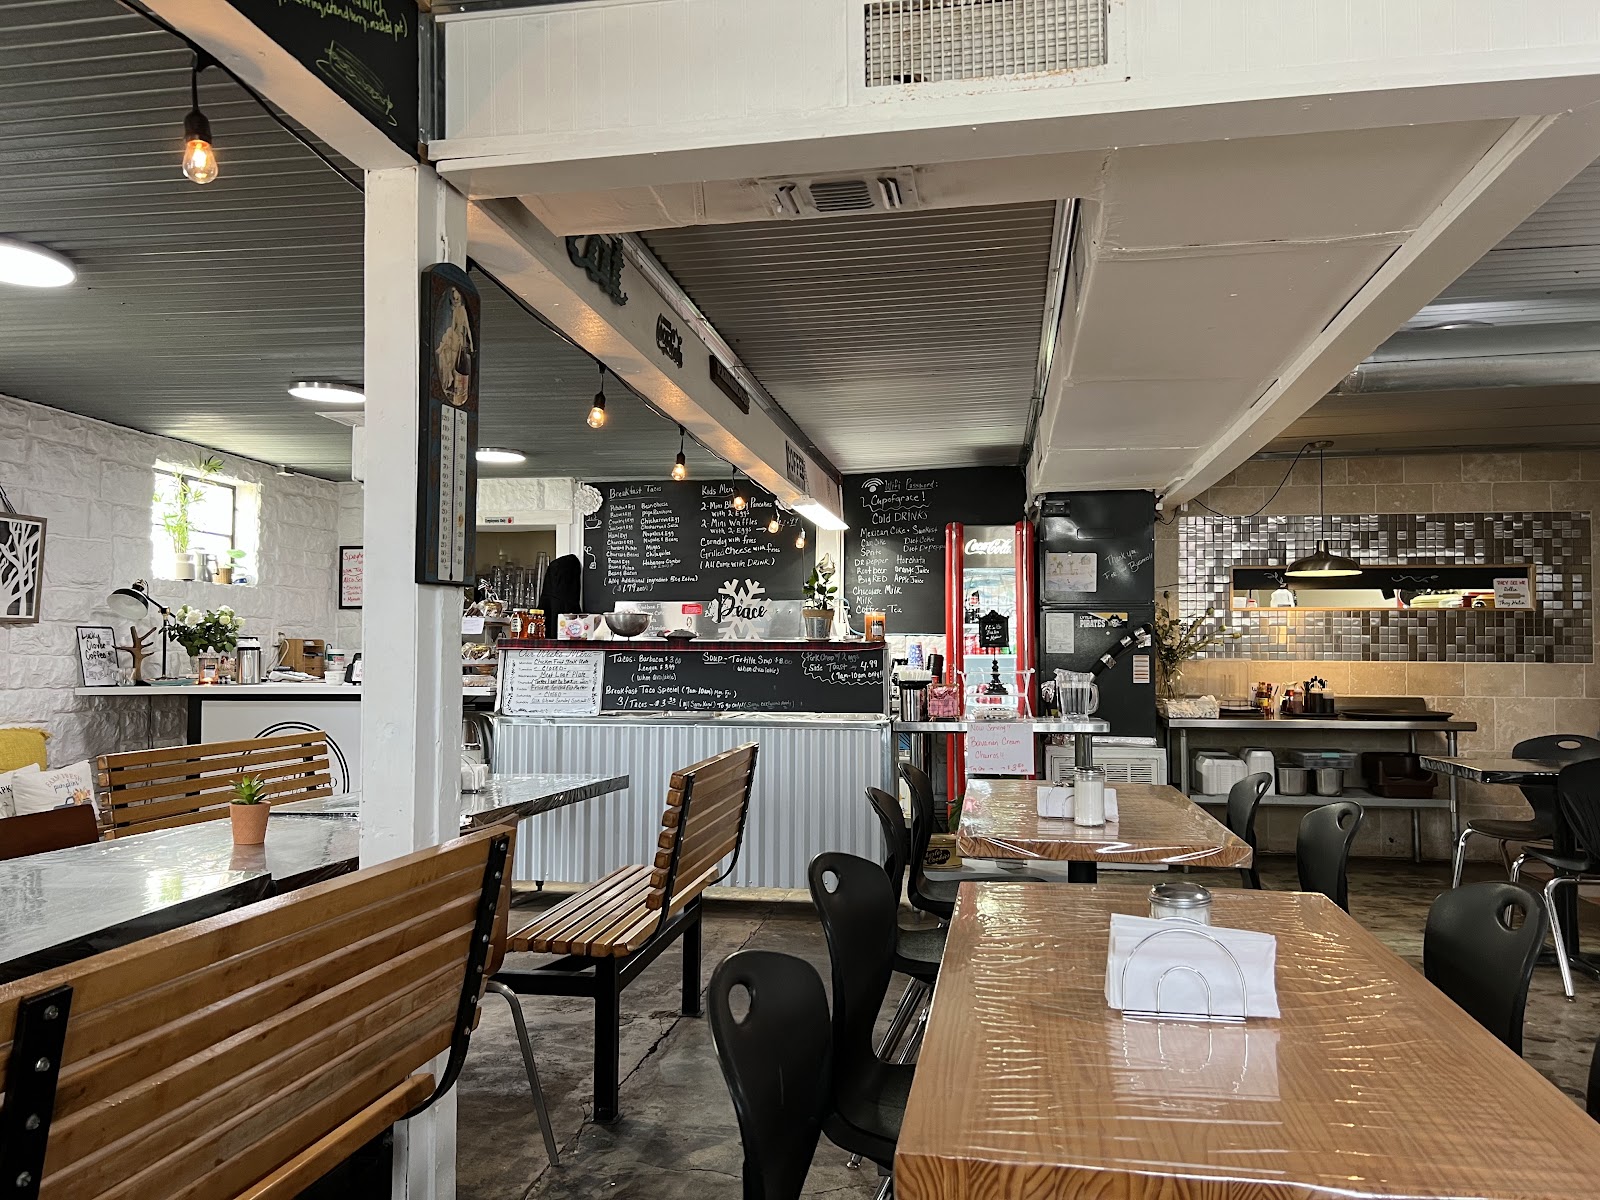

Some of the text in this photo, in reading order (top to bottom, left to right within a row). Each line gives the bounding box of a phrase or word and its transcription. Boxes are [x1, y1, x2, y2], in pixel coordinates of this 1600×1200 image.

[609, 484, 662, 499] Breakfast Tacos
[701, 484, 717, 496] Kids
[750, 496, 773, 508] Pancakes
[728, 518, 758, 527] Waffles
[871, 512, 891, 525] Cold
[710, 527, 726, 535] with
[860, 527, 889, 539] Mexican
[700, 537, 727, 548] Corndog
[700, 548, 725, 560] Grilled
[725, 546, 752, 555] Cheese
[903, 544, 918, 553] Diet
[1104, 551, 1127, 566] Thank
[914, 565, 930, 574] Juice
[857, 575, 872, 586] Big
[884, 583, 903, 595] Milk
[856, 595, 873, 605] Milk
[718, 594, 768, 624] Peace
[886, 603, 903, 613] Tea
[1079, 619, 1106, 628] PIRATES
[806, 652, 820, 662] Pork
[826, 662, 848, 672] Toast
[860, 659, 878, 672] 4.99
[605, 684, 680, 695] Breakfast Taco Special
[970, 736, 1021, 748] Bavarian Cream
